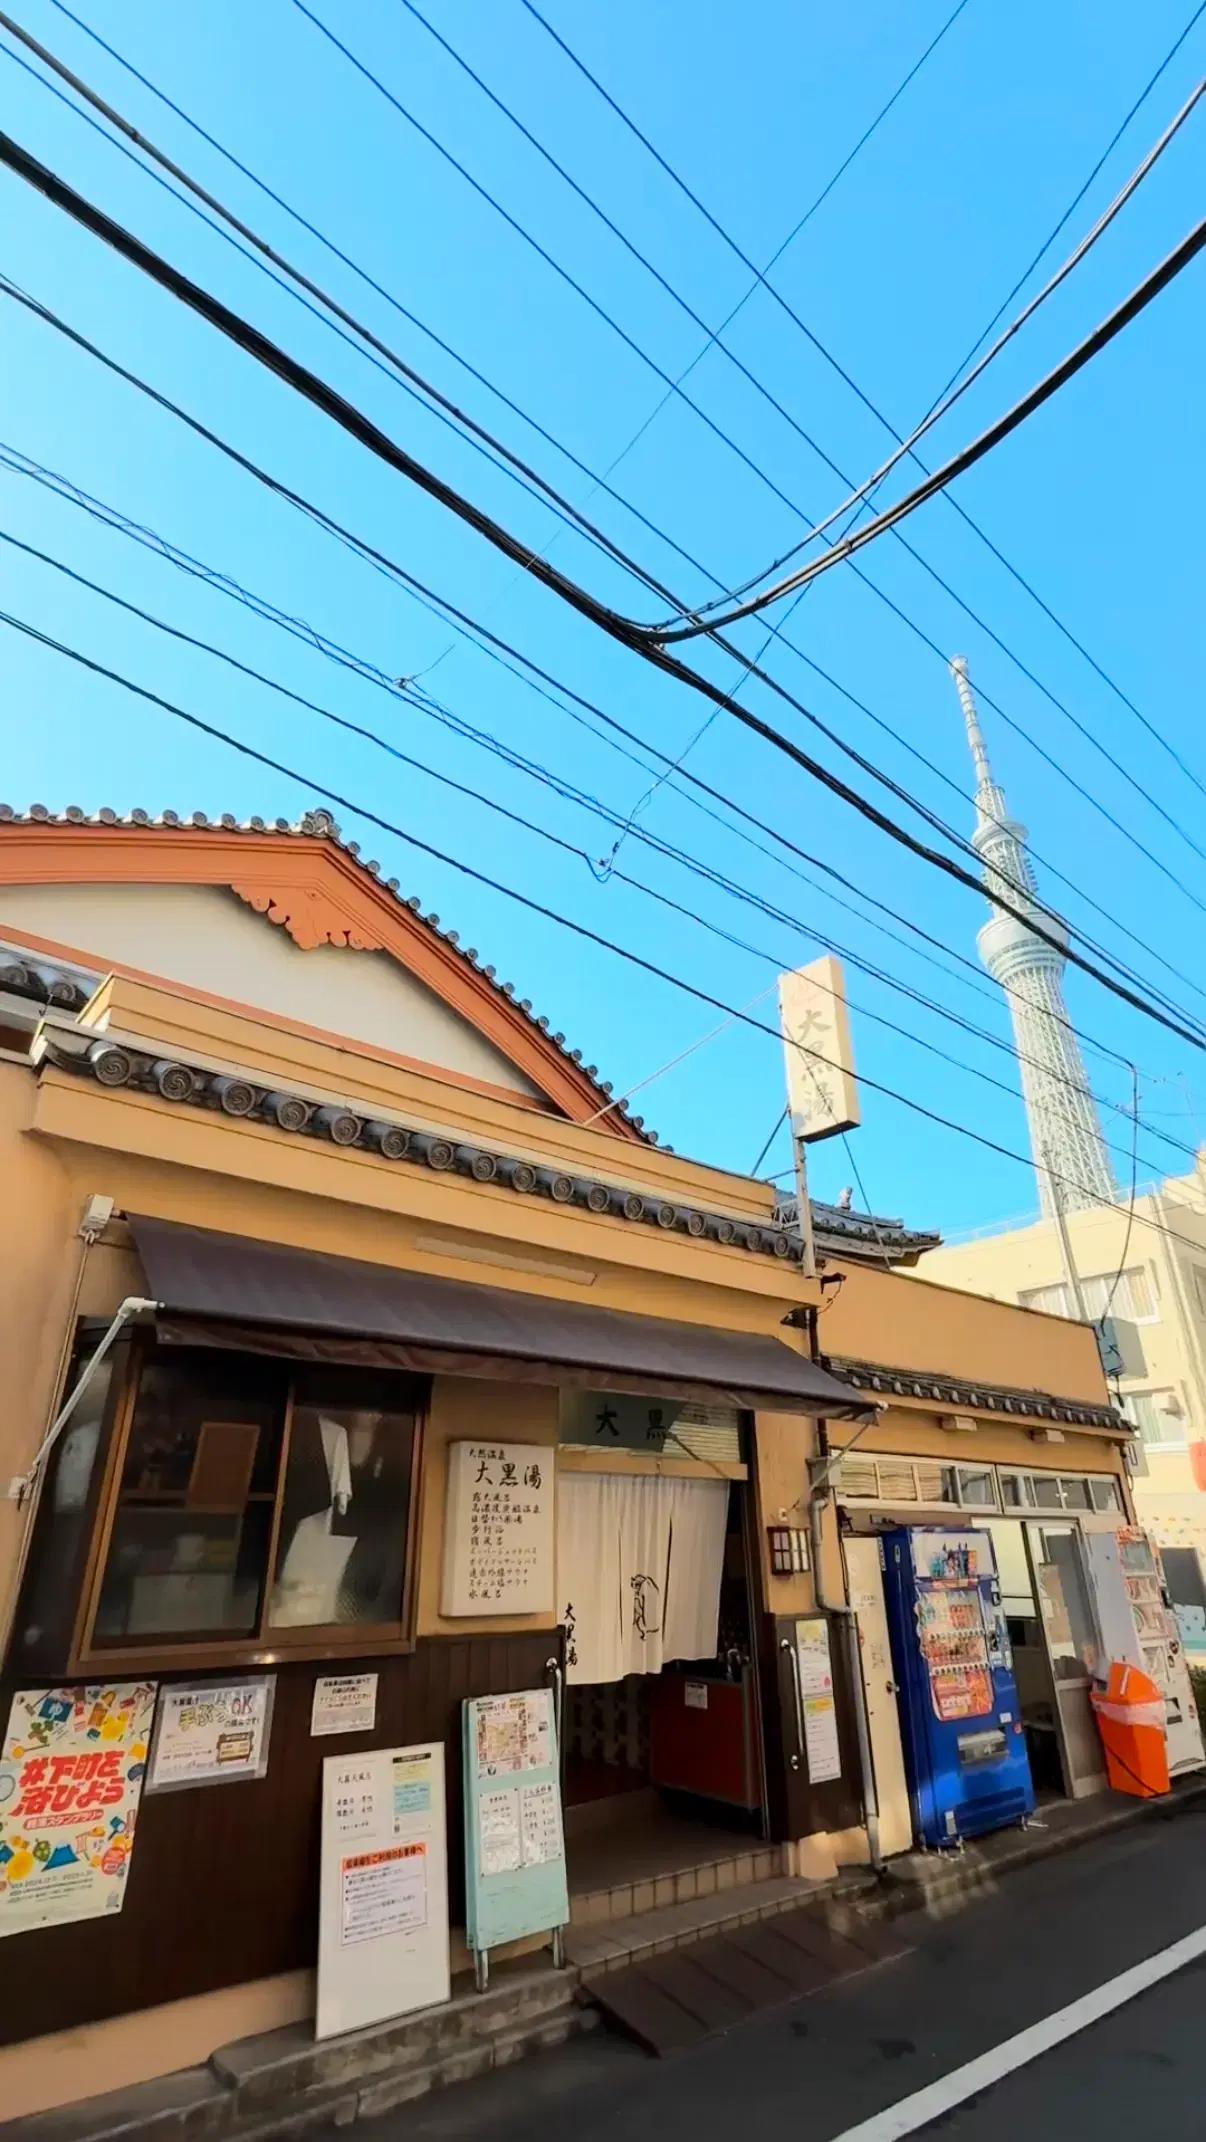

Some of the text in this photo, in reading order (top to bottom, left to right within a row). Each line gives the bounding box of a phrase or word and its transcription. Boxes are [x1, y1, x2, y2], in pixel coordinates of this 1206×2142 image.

[797, 1008, 835, 1123] 大黒湯
[474, 1460, 543, 1490] 大黒湯
[8, 1777, 125, 1817] 浴びよう
